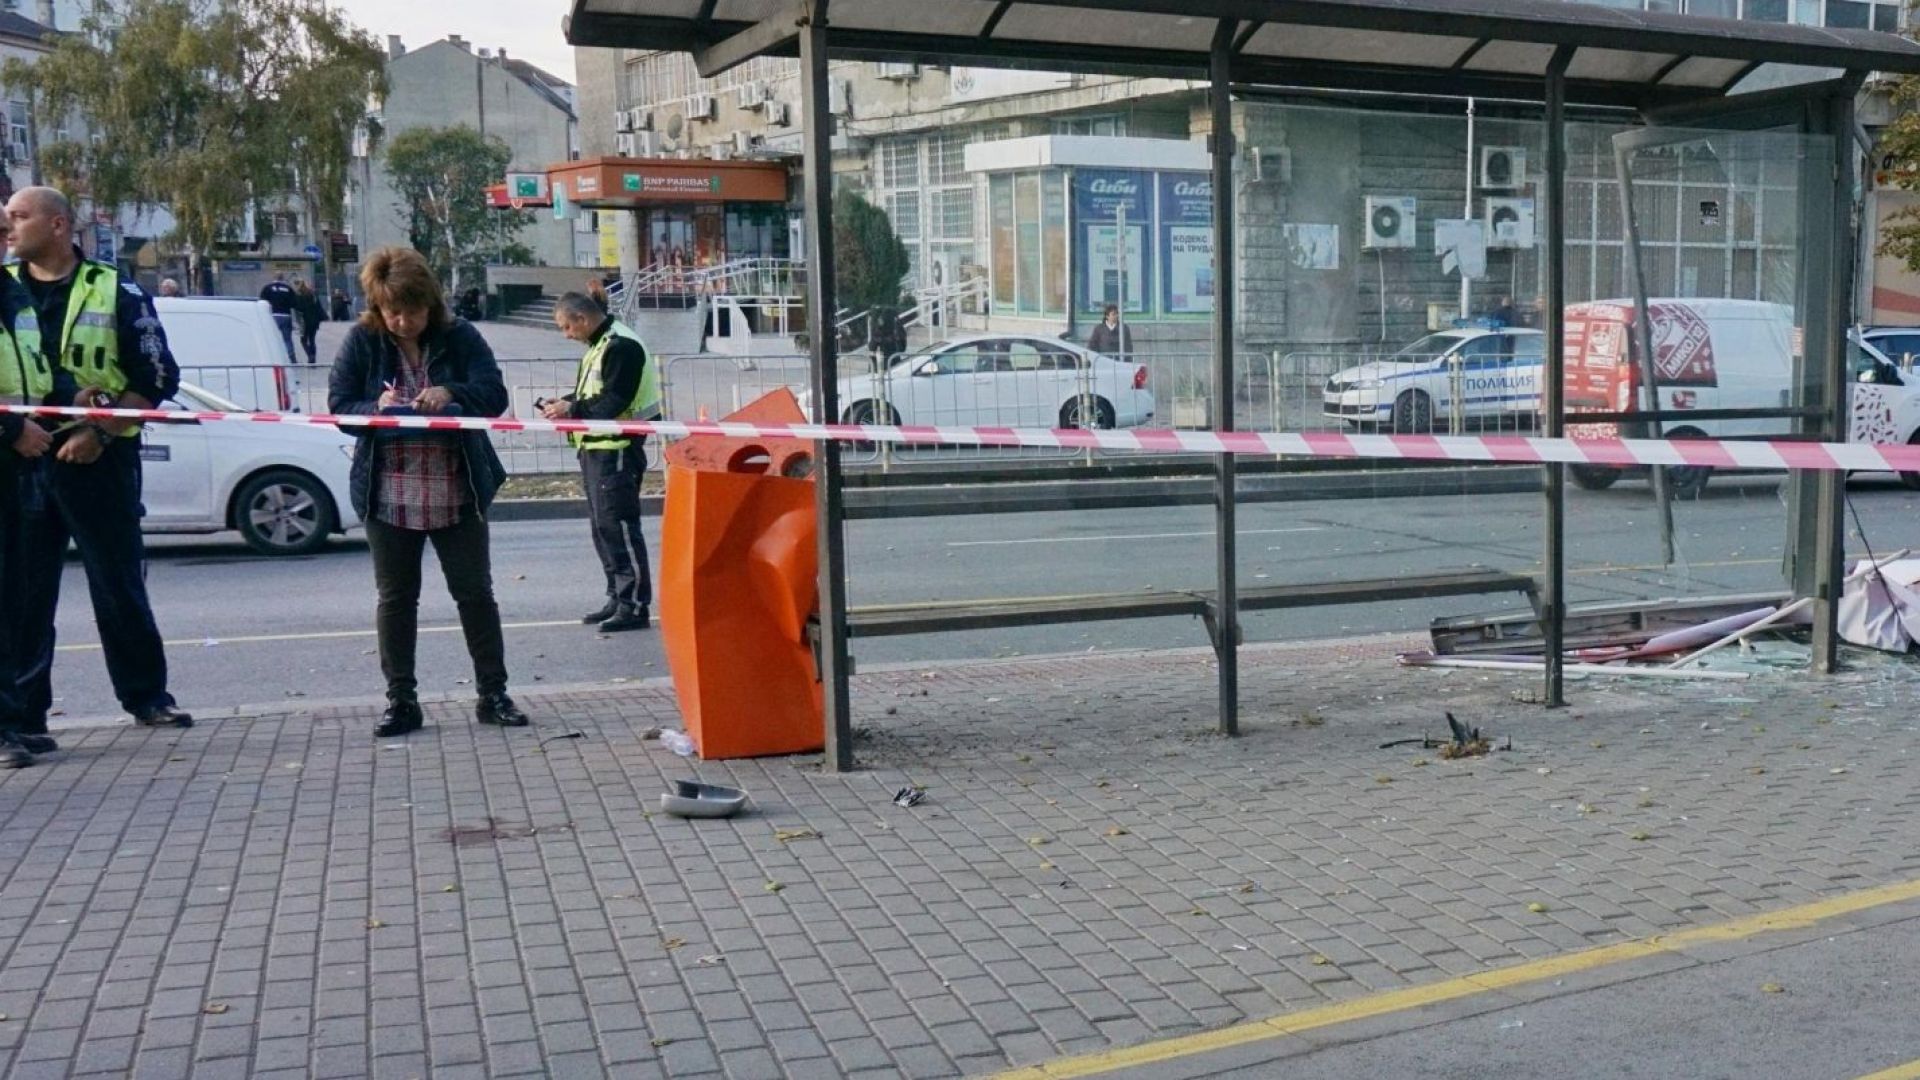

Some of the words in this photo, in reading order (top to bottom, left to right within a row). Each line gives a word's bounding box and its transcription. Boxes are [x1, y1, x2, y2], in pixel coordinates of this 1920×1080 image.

[1173, 235, 1208, 244] КОДЕКС
[1173, 245, 1184, 253] НА
[1466, 376, 1534, 390] ПОЛИЦИЯ
